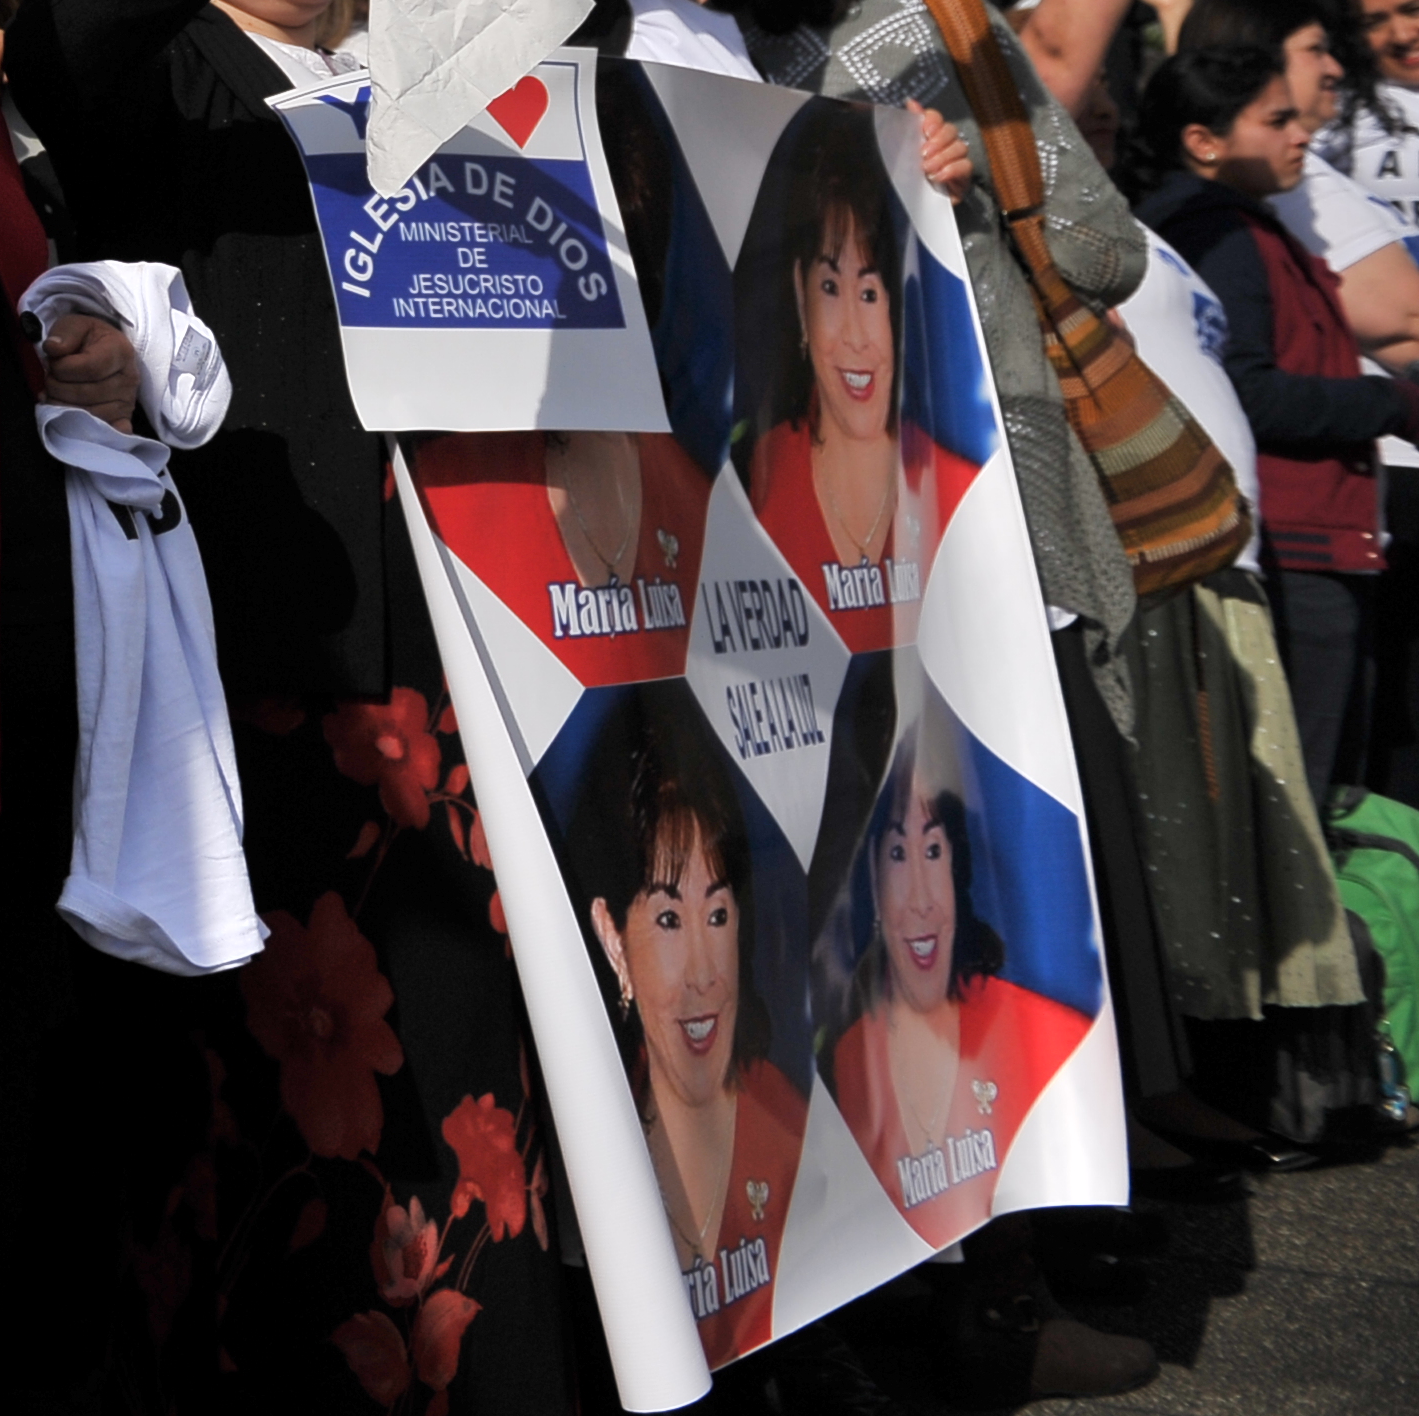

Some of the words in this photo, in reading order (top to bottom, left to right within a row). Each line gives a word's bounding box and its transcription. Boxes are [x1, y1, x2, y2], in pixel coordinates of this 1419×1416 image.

[342, 161, 455, 299] IGLESIA
[464, 161, 517, 209] DE
[525, 196, 608, 302] DIOS
[398, 221, 534, 245] MINISTERIAL
[456, 246, 490, 269] DE
[392, 297, 568, 320] INTERNACIONAL
[408, 273, 545, 296] JESUCRISTO
[548, 575, 639, 639] María
[636, 576, 687, 630] Luisa
[821, 555, 886, 612] María
[702, 582, 737, 655] LA
[726, 578, 811, 653] VERDAD
[945, 1127, 997, 1185] Luisa
[683, 1255, 721, 1320] ría
[718, 1235, 772, 1306] Luisa
